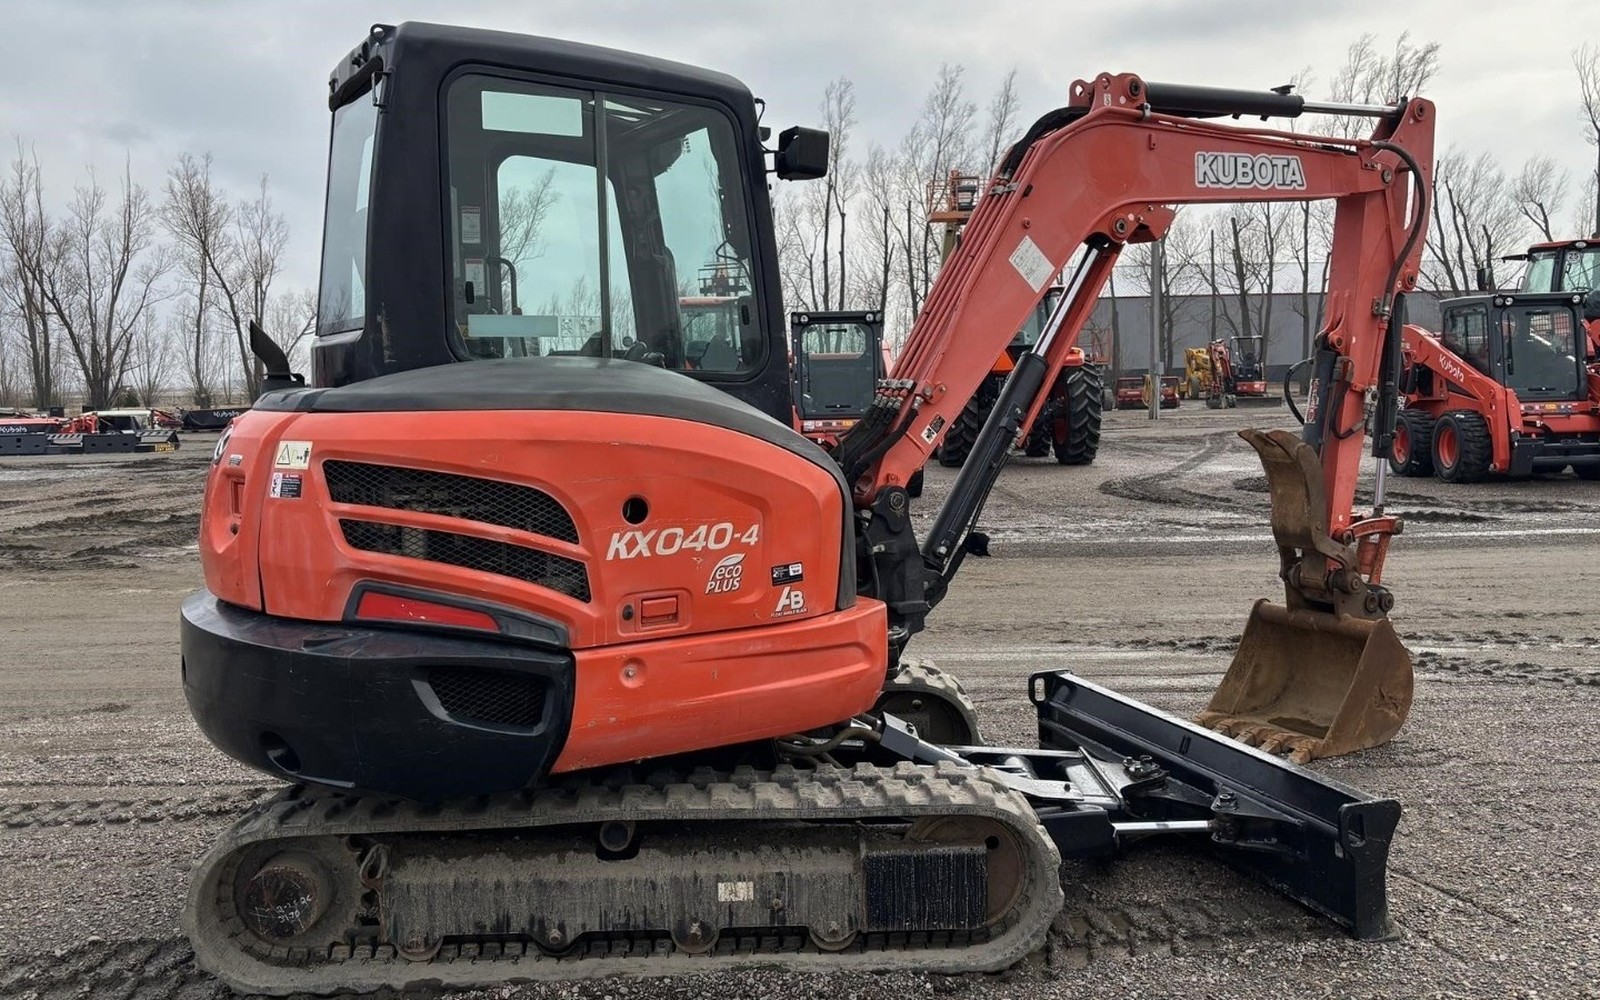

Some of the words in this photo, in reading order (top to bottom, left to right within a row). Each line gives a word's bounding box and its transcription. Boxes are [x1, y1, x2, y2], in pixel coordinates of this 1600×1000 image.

[1196, 152, 1305, 188] KUBOTA
[1438, 353, 1466, 383] Kubota
[213, 410, 240, 418] Kubota
[605, 522, 760, 561] KX040-4
[715, 564, 743, 580] eco
[705, 577, 742, 595] PLUS
